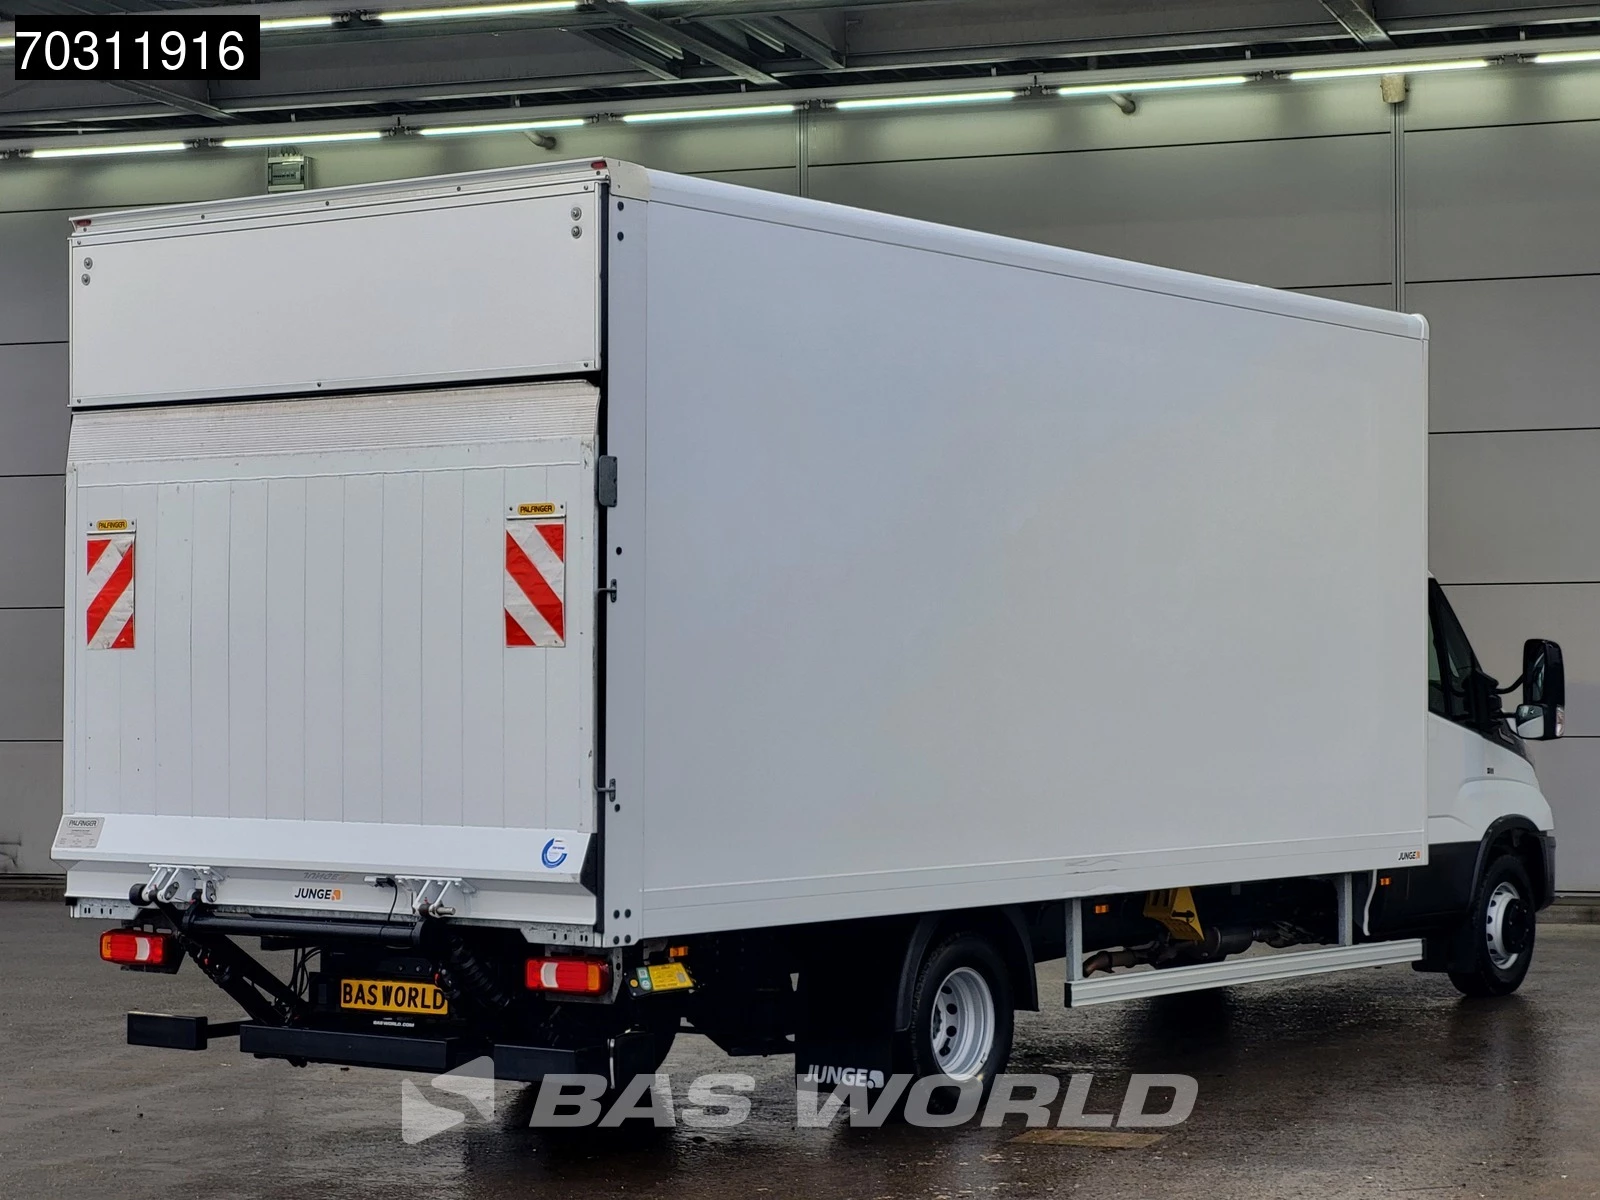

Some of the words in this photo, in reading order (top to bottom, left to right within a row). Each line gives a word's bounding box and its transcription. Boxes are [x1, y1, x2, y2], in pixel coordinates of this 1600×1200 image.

[519, 504, 553, 514] PALFINGER
[1398, 850, 1417, 861] JUNGE
[294, 887, 333, 900] JUNGE
[342, 982, 378, 1006] BAS
[381, 985, 445, 1010] WORLD
[803, 1064, 869, 1087] JUNGE
